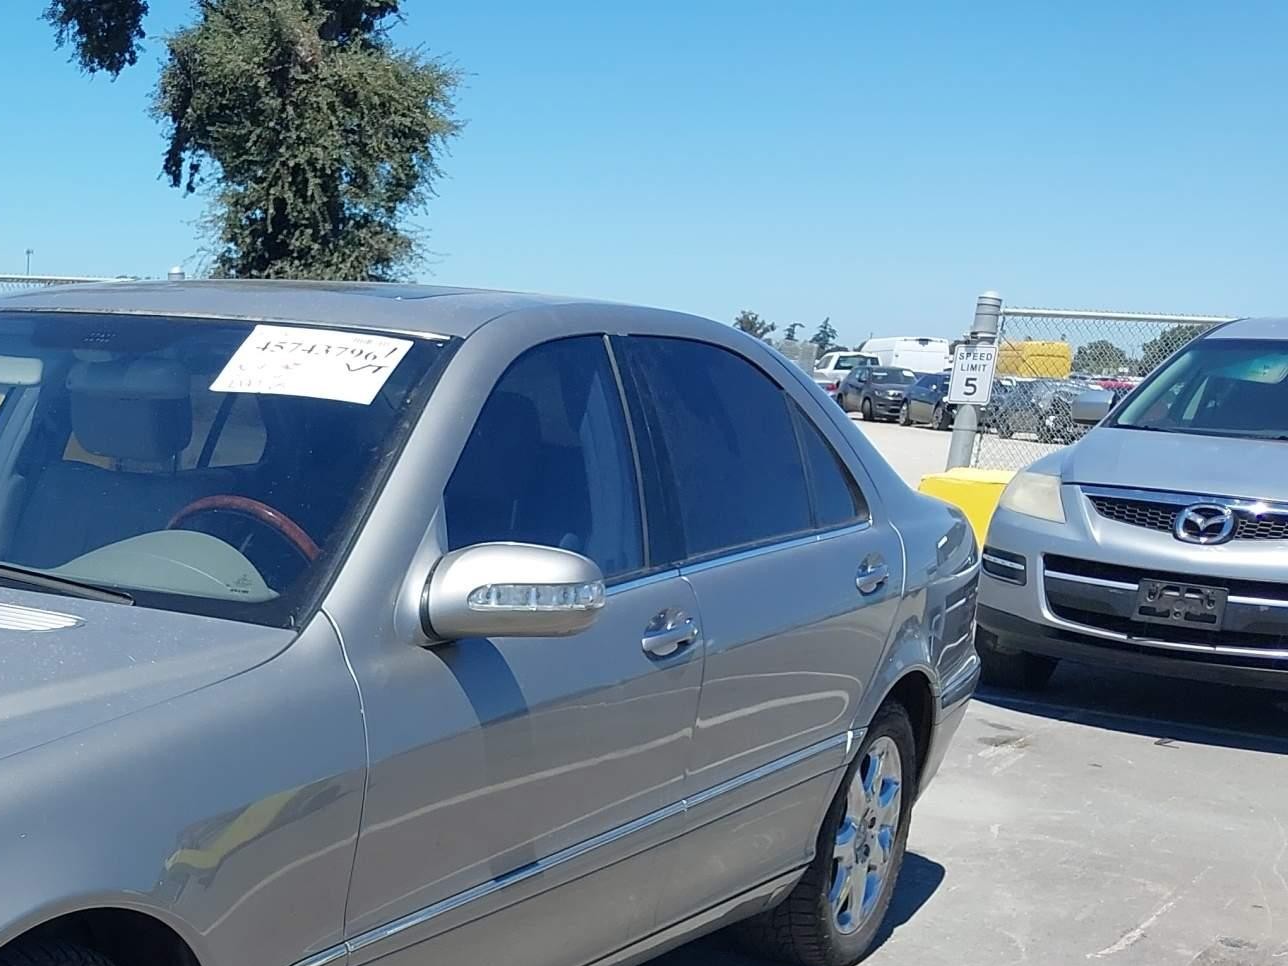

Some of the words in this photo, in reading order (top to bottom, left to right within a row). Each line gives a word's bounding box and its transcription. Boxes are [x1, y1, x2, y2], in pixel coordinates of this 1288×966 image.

[958, 352, 993, 361] SPEED
[960, 363, 987, 372] LIMIT
[963, 377, 977, 396] 5
